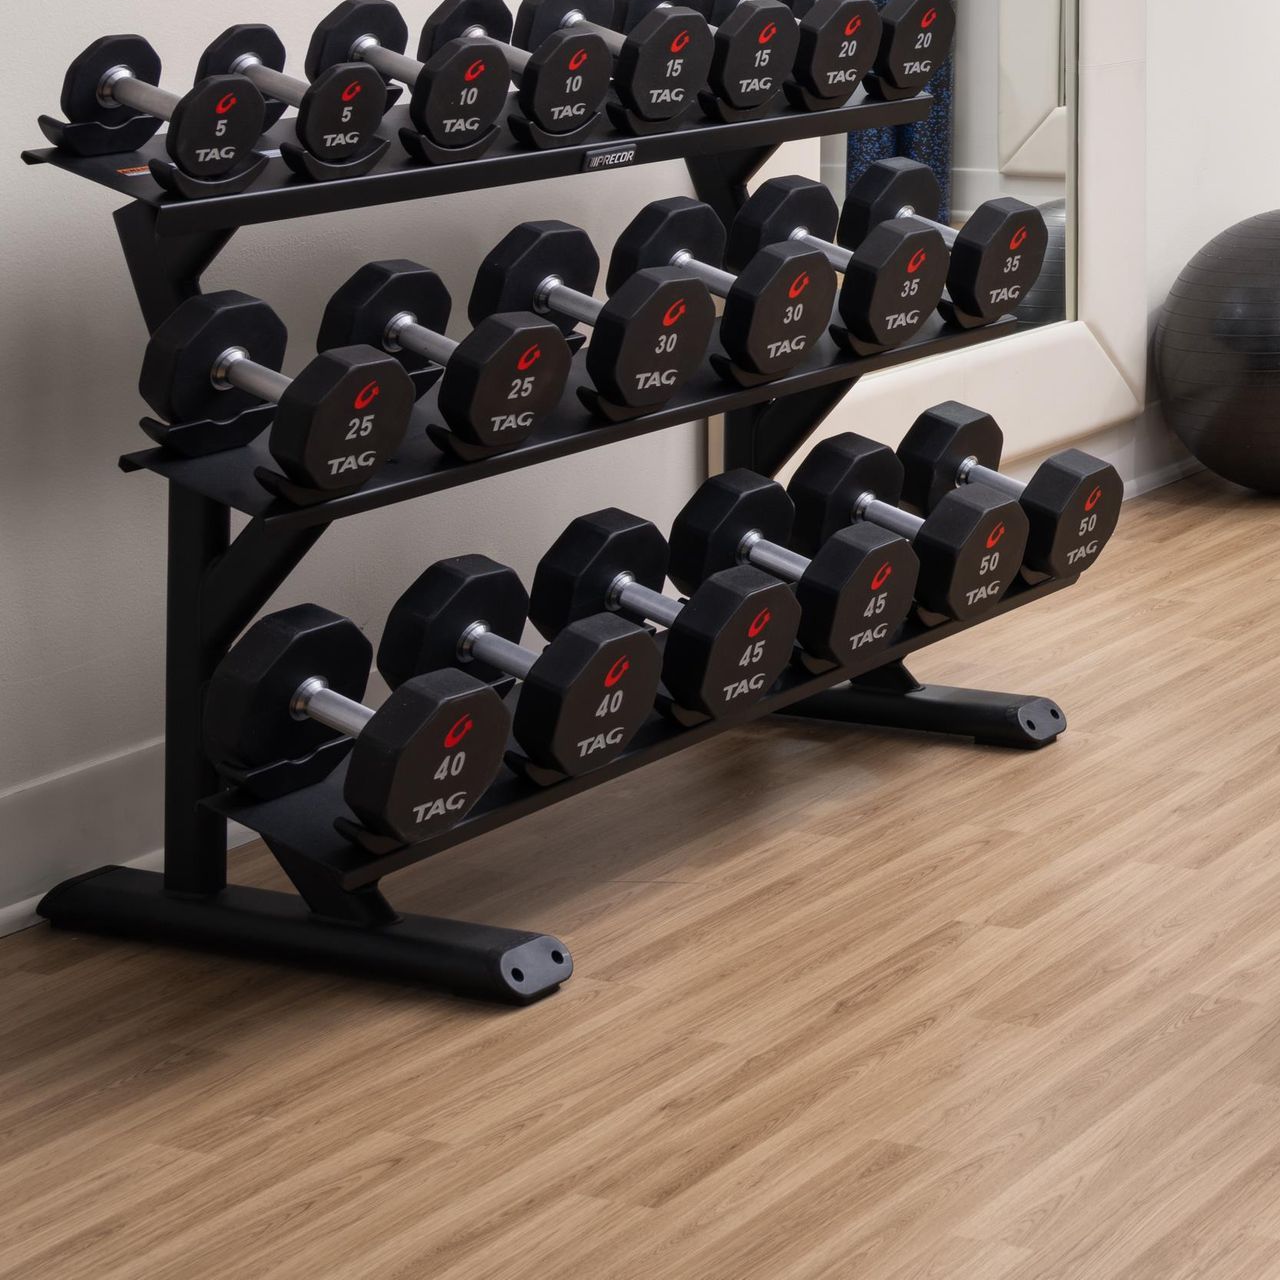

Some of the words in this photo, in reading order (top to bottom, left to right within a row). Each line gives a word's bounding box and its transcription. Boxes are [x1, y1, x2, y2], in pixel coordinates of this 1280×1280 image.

[839, 41, 856, 57] 20
[915, 33, 932, 49] 20
[666, 59, 683, 77] 15
[755, 50, 771, 67] 15
[904, 60, 931, 74] TAG
[566, 76, 582, 93] 10
[739, 77, 772, 92] TAG
[826, 68, 858, 85] TAG
[460, 88, 478, 105] 10
[650, 88, 684, 103] TAG
[342, 107, 352, 122] 5
[551, 103, 586, 119] TAG
[216, 120, 227, 136] 5
[443, 118, 480, 132] TAG
[324, 132, 359, 146] TAG
[196, 147, 235, 161] TAG
[593, 150, 635, 167] PRECOR
[1004, 255, 1021, 273] 35
[901, 279, 920, 297] 35
[990, 285, 1020, 303] TAG
[784, 304, 803, 323] 30
[886, 310, 920, 329] TAG
[655, 334, 677, 353] 30
[767, 336, 806, 358] TAG
[508, 377, 534, 399] 25
[636, 369, 677, 389] TAG
[345, 415, 374, 440] 25
[491, 412, 534, 431] TAG
[328, 451, 376, 474] TAG
[1079, 514, 1096, 536] 50
[1067, 540, 1099, 563] TAG
[980, 552, 999, 575] 50
[966, 581, 1000, 605] TAG
[864, 592, 887, 617] 45
[850, 623, 888, 649] TAG
[739, 640, 765, 666] 45
[724, 673, 765, 701] TAG
[596, 690, 623, 717] 40
[578, 727, 624, 757] TAG
[434, 752, 465, 780] 40
[413, 791, 467, 823] TAG
